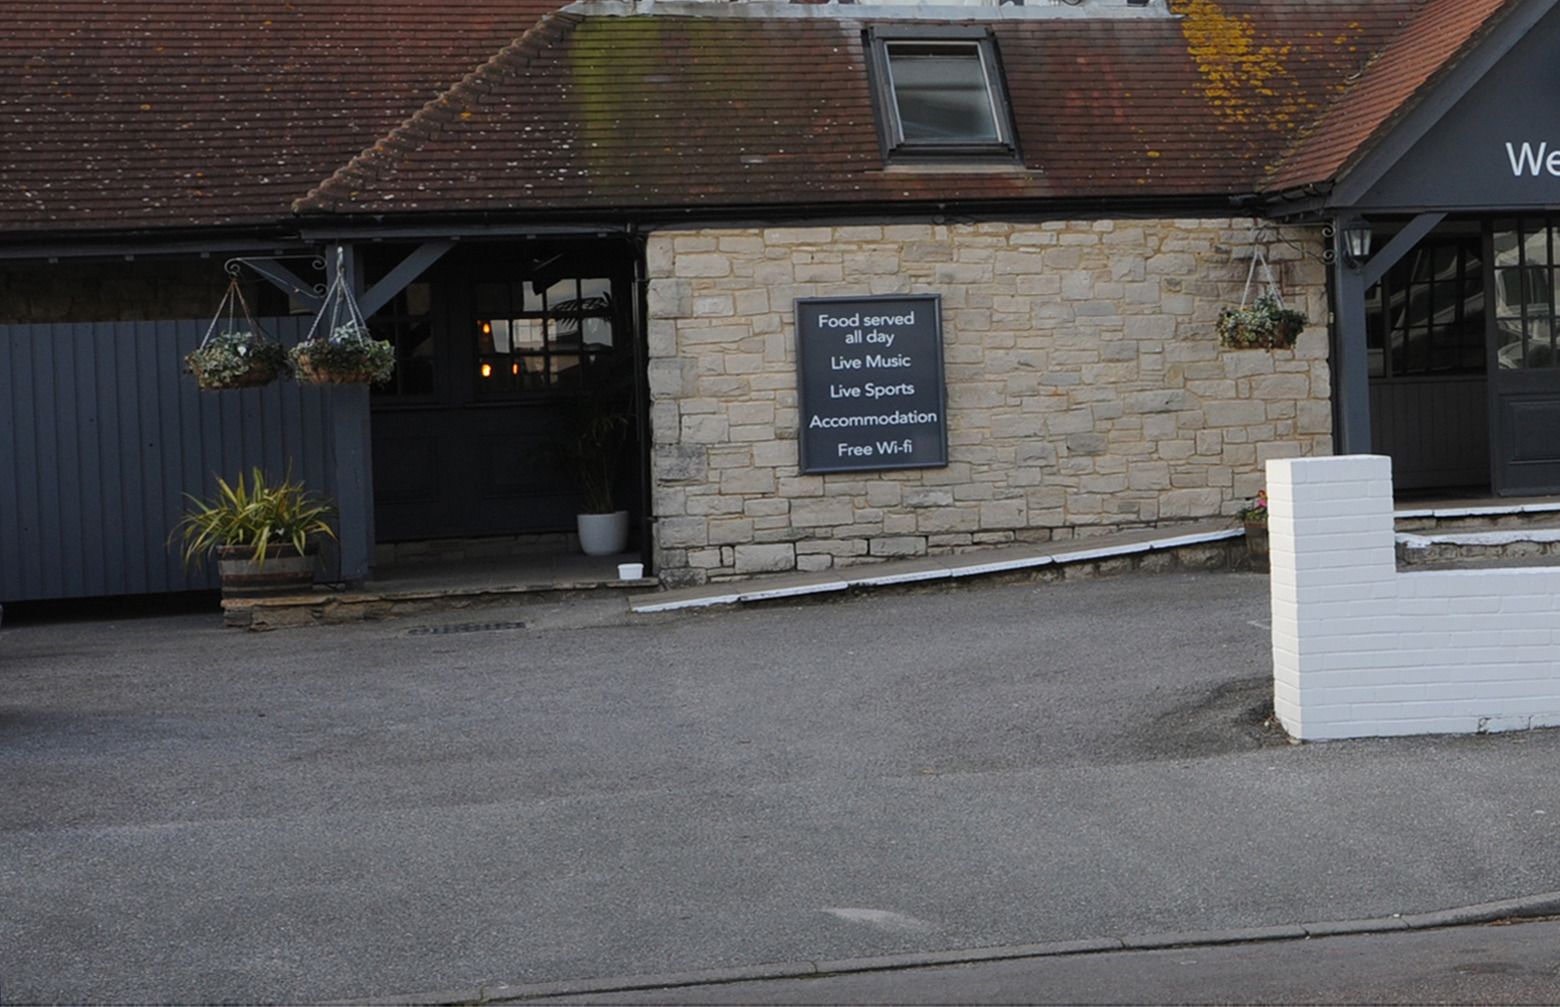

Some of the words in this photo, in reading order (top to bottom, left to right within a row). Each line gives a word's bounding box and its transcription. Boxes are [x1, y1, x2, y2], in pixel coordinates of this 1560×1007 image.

[818, 313, 860, 328] Food
[863, 311, 915, 326] served
[845, 330, 862, 344] all
[866, 329, 895, 347] day
[831, 356, 862, 370] Live
[866, 354, 912, 368] Music
[830, 384, 861, 398] Live
[865, 382, 915, 400] Sports
[809, 410, 938, 429] Accommodation
[838, 443, 873, 457] Free
[876, 439, 913, 455] Wi-fi
